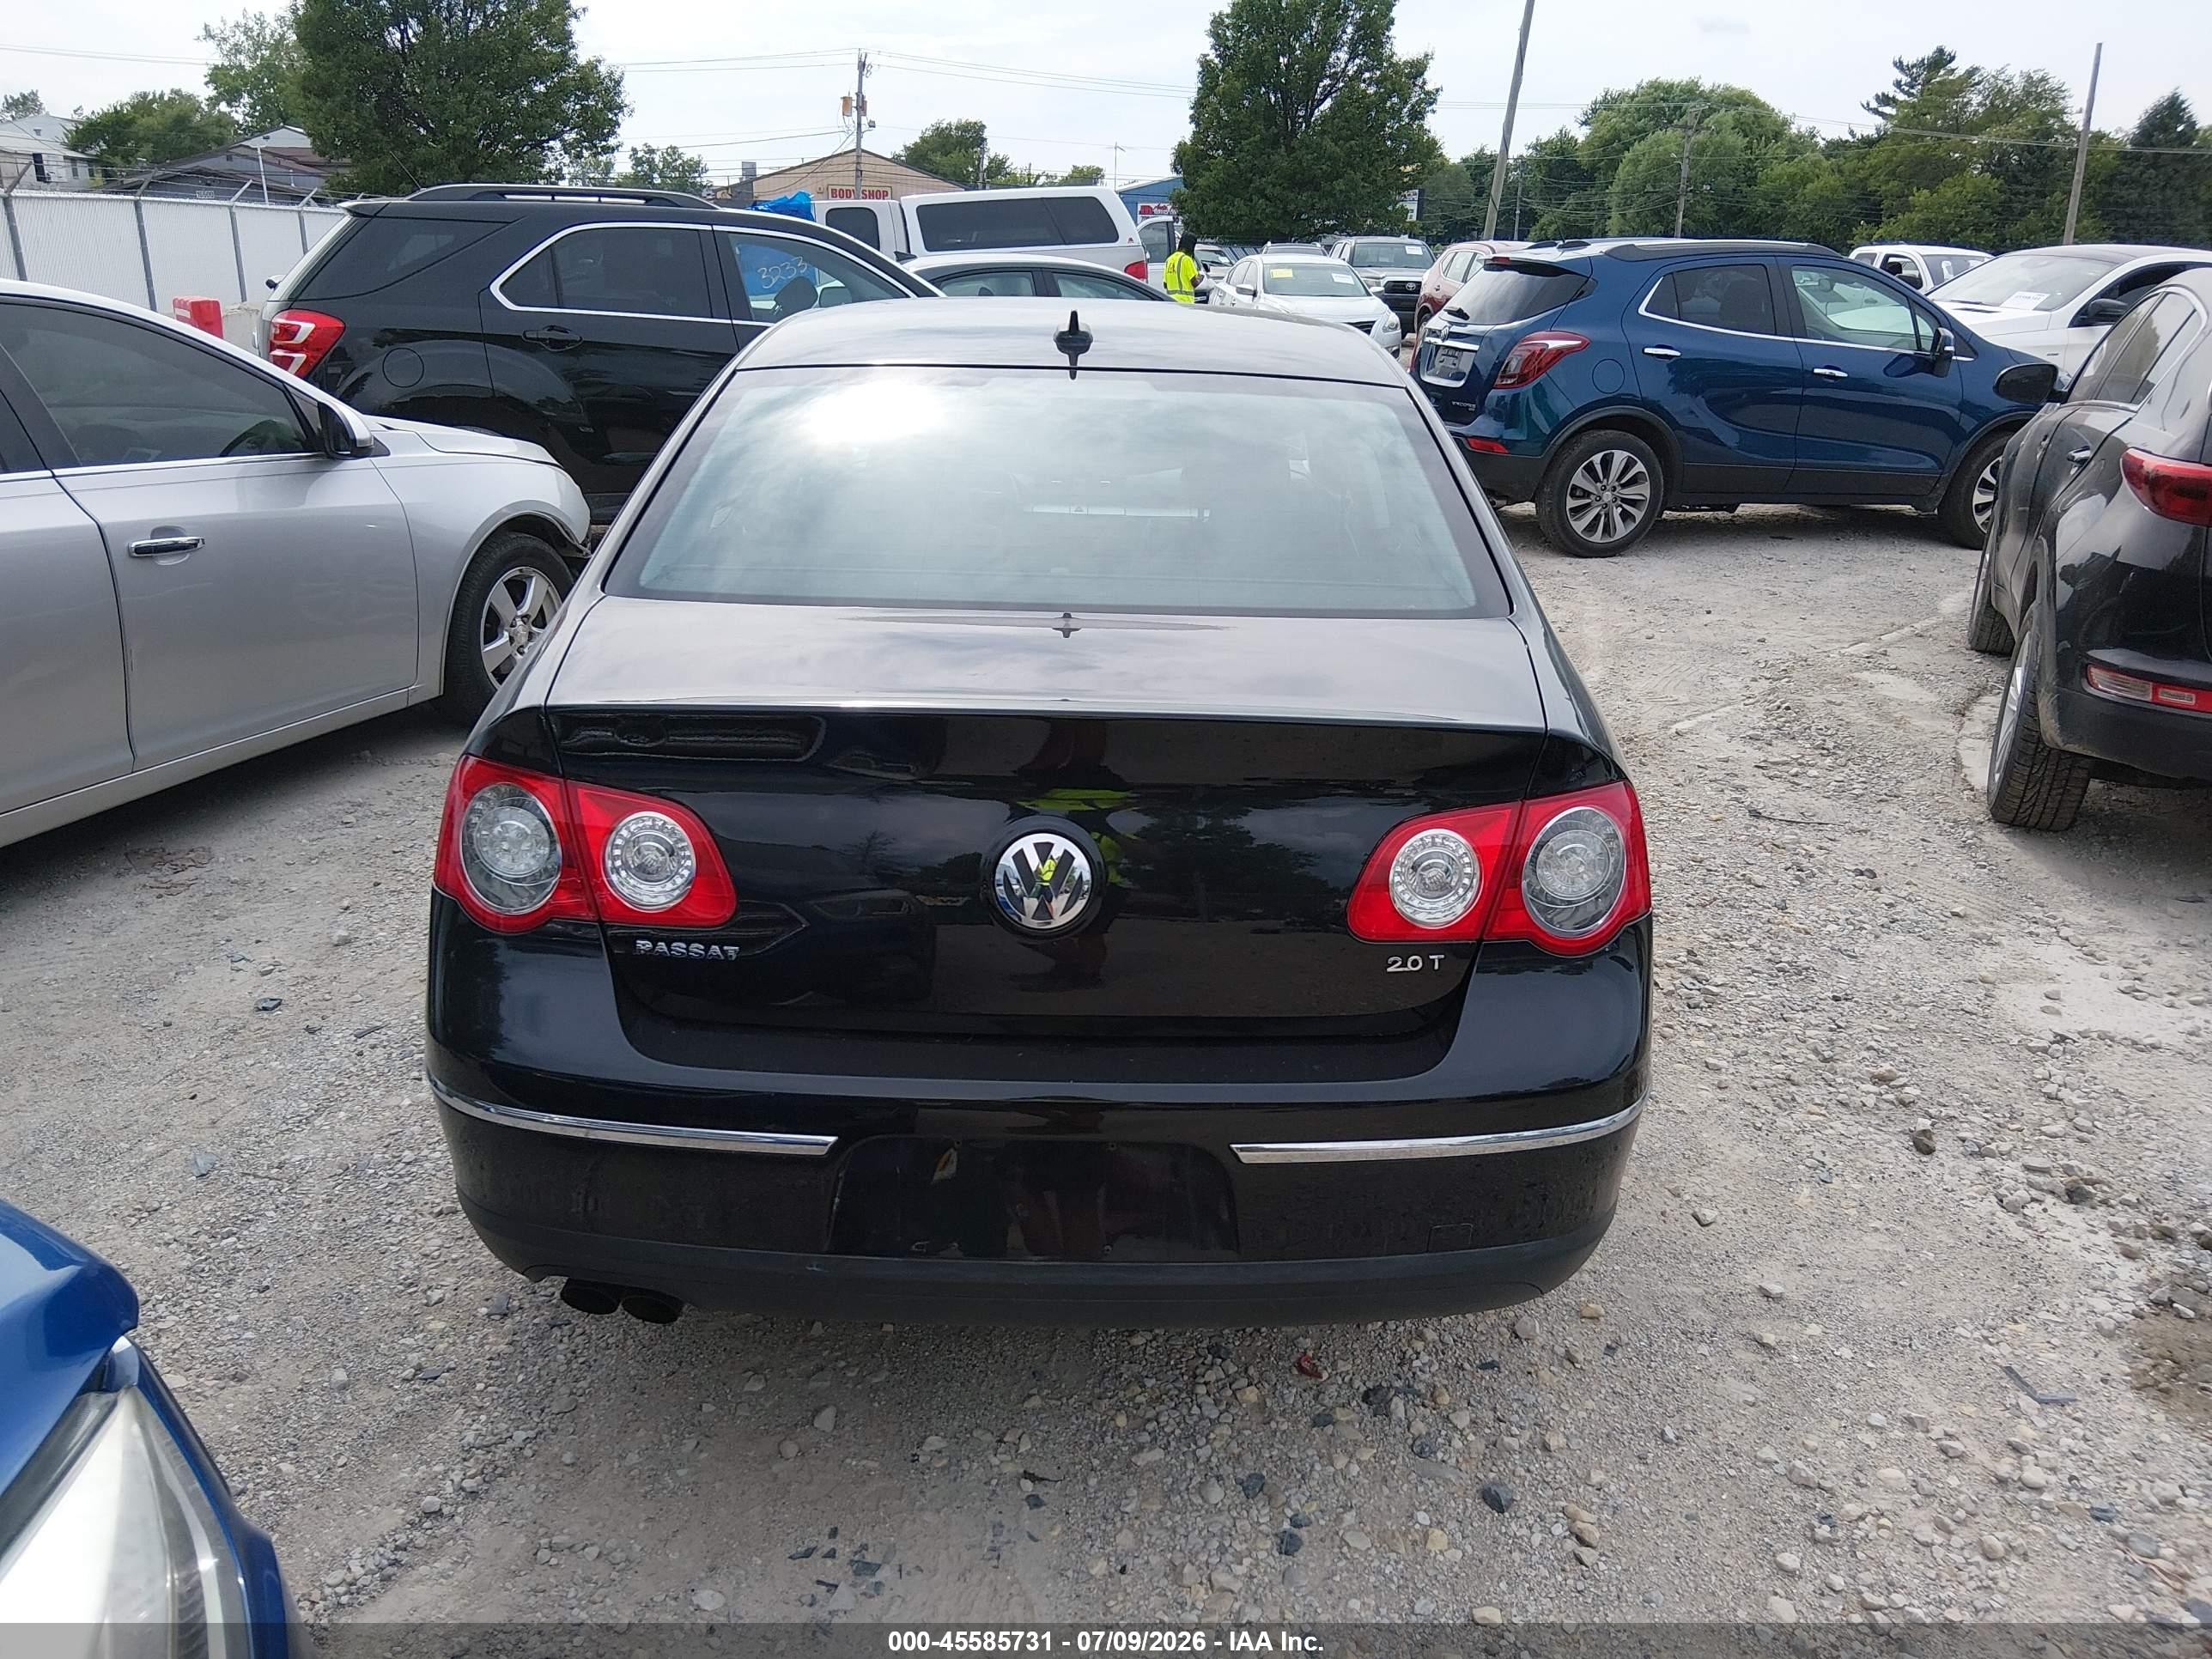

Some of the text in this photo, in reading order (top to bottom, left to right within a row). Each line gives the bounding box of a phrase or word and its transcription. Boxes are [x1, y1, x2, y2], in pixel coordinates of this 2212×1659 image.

[861, 190, 889, 200] SHOP
[633, 940, 739, 960] PASSAT
[1428, 954, 1445, 970] T
